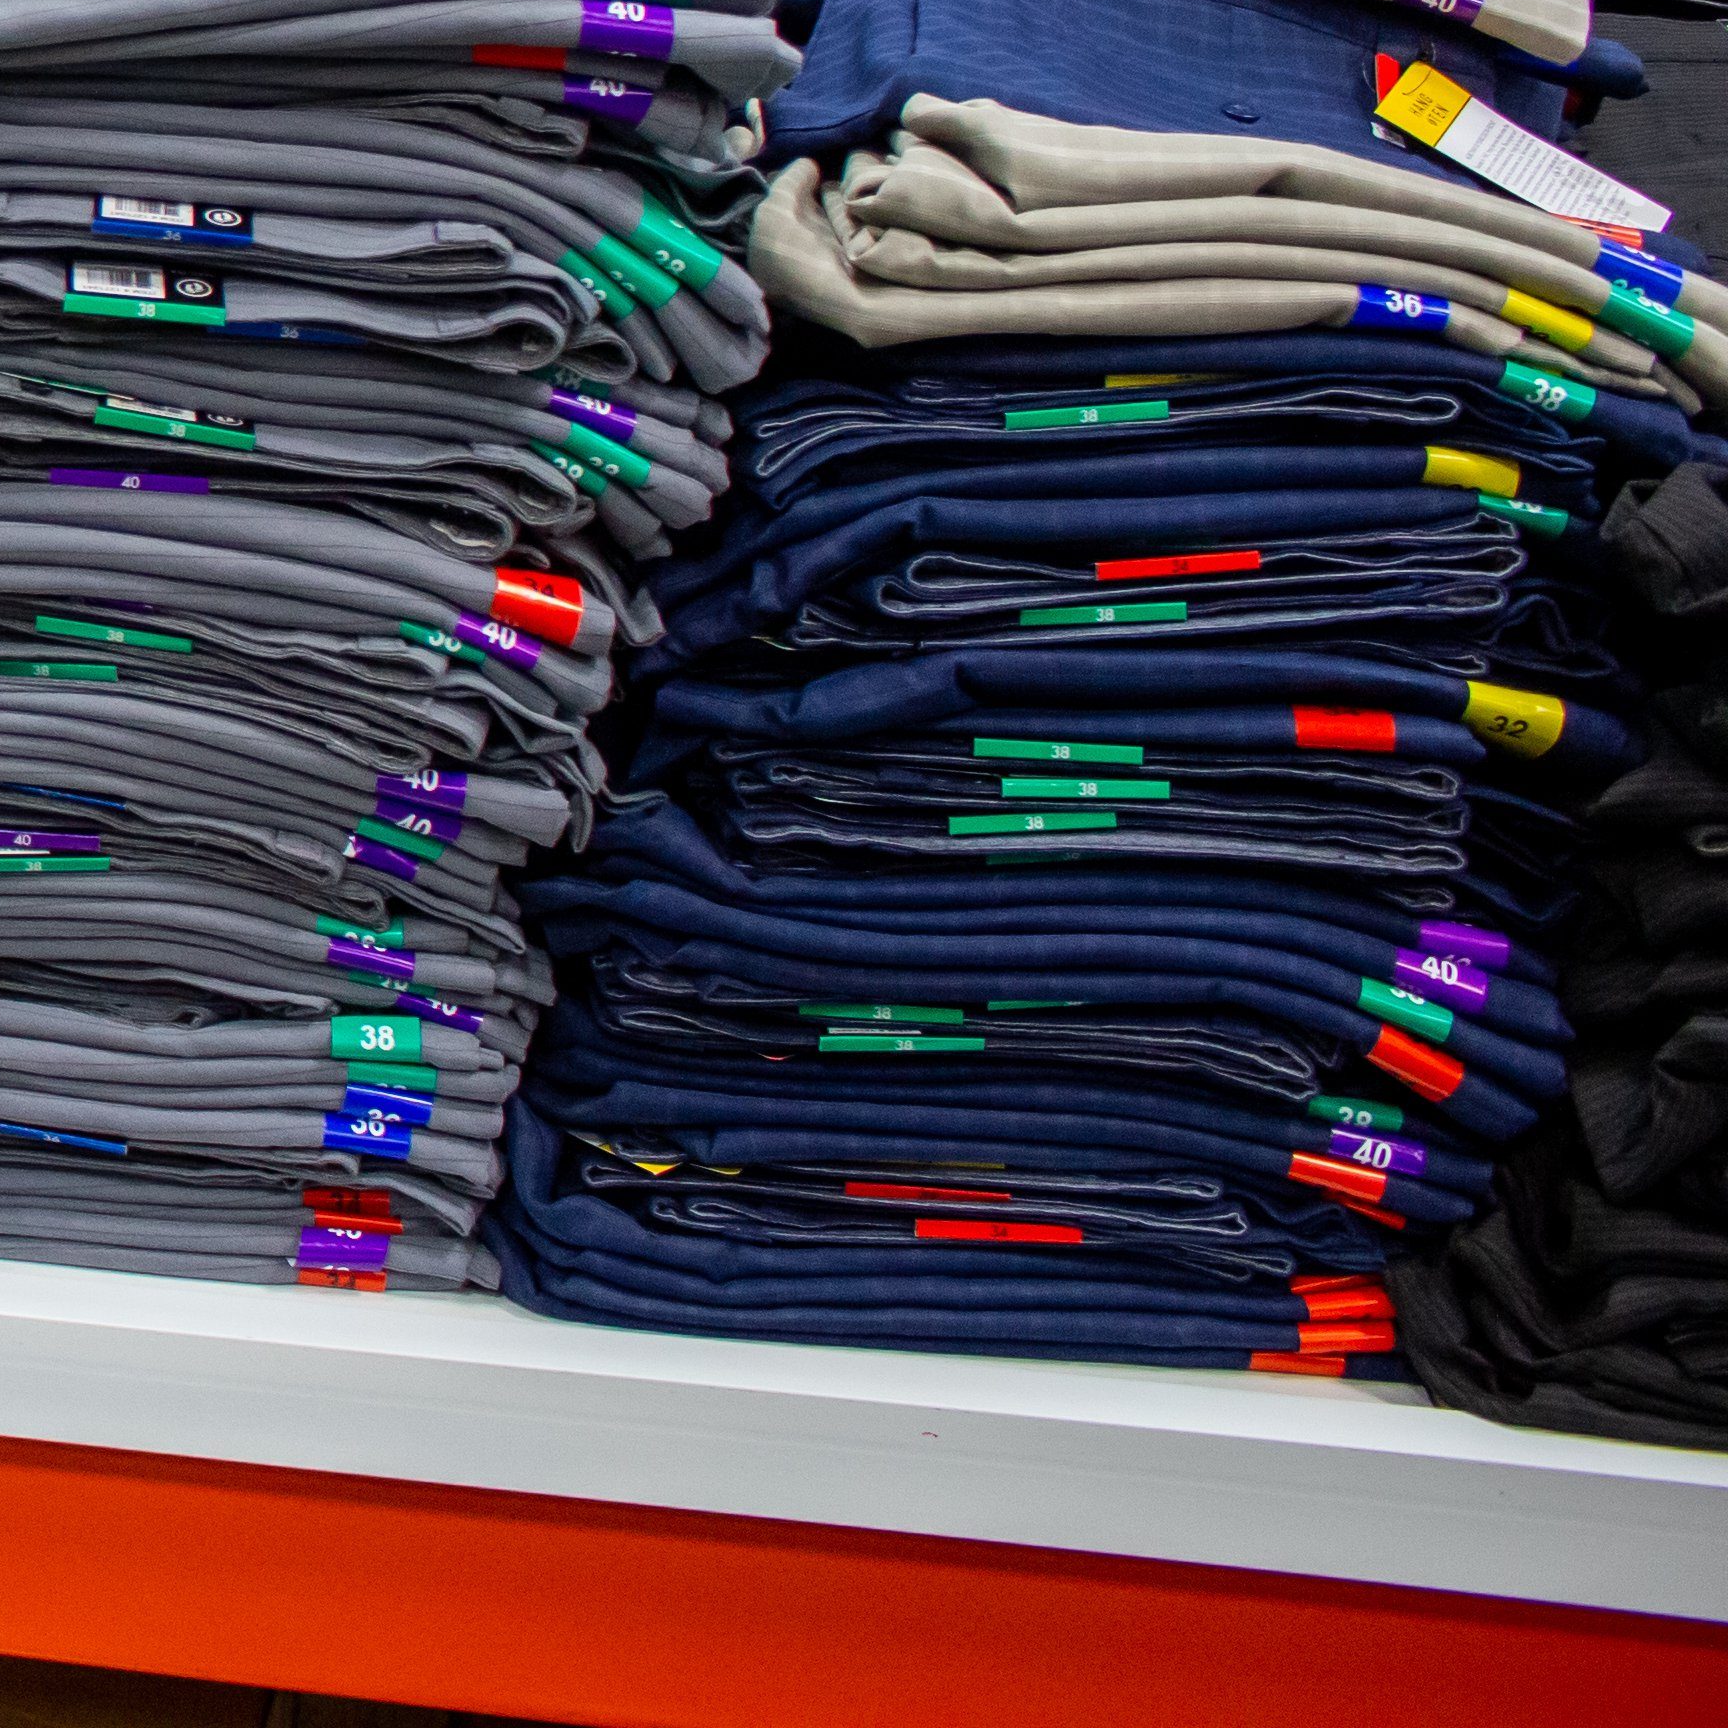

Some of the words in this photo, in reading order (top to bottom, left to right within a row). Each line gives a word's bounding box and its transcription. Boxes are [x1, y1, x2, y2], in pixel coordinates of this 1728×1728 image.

[607, 1, 648, 23] 40
[1409, 91, 1434, 119] HANG
[137, 302, 157, 318] 38
[1384, 288, 1424, 319] 36
[1524, 377, 1569, 412] 38
[1079, 408, 1099, 424] 38
[120, 475, 141, 490] 40
[1095, 608, 1116, 623] 38
[481, 621, 518, 651] 40
[1487, 714, 1530, 740] 32
[1050, 744, 1071, 760] 38
[402, 769, 439, 793] 40
[1078, 781, 1099, 797] 38
[1024, 815, 1044, 831] 38
[13, 833, 32, 847] 40
[1421, 954, 1459, 986] 40
[872, 1005, 893, 1022] 38
[359, 1023, 397, 1053] 38
[894, 1038, 915, 1053] 38
[1352, 1137, 1393, 1171] 40
